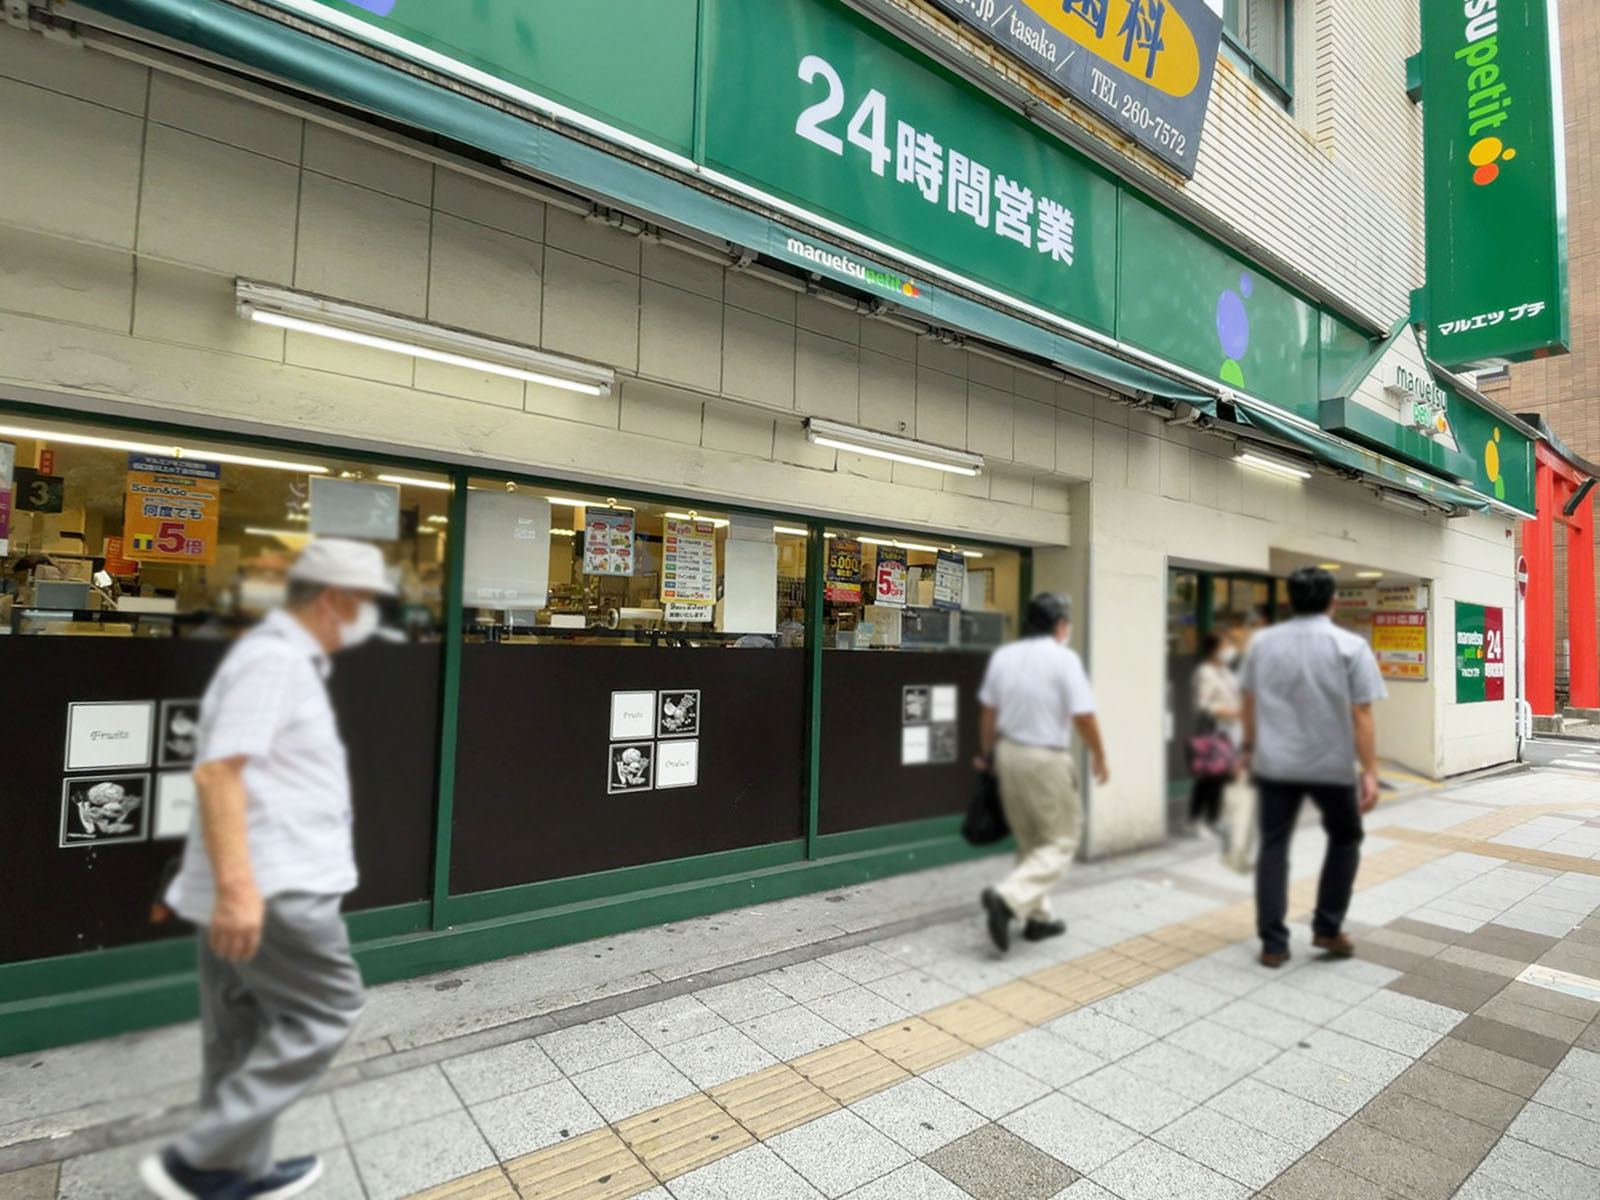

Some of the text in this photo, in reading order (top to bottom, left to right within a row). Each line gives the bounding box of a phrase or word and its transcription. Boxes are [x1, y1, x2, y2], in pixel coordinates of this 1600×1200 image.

[1090, 67, 1119, 110] TEL
[1121, 95, 1187, 157] 260-7572
[795, 54, 1075, 267] 24時間営業
[1438, 301, 1545, 336] マルエツ プチ
[1397, 365, 1447, 411] maruetsu
[29, 480, 49, 506] 3
[131, 483, 188, 497] Scan&Go
[143, 503, 203, 520] 何度でも
[1486, 629, 1502, 660] 24
